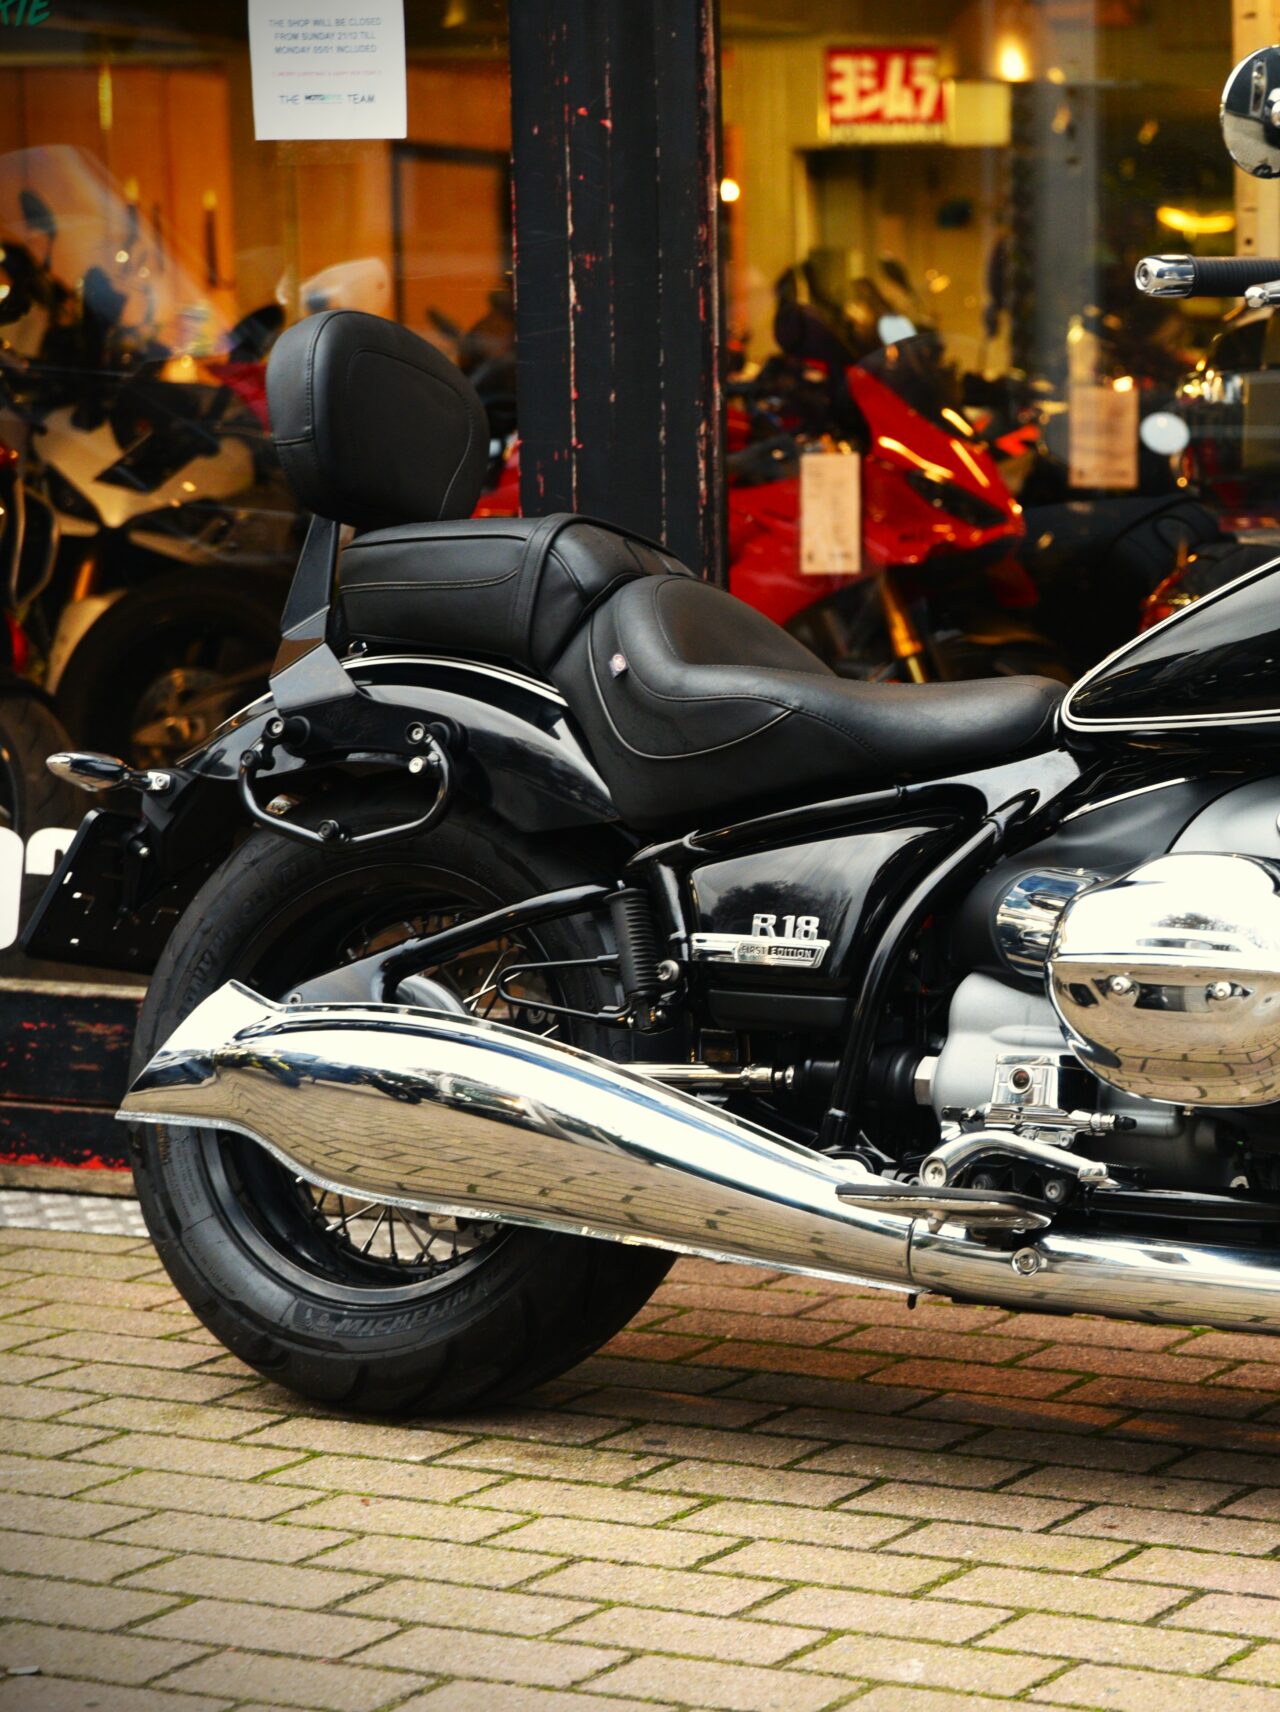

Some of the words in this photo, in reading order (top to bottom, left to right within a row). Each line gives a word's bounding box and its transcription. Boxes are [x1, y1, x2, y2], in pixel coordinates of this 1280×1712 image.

[268, 18, 285, 28] THE
[287, 18, 311, 28] SHOP
[313, 18, 333, 27] WILL
[335, 18, 346, 27] BE
[349, 17, 382, 26] CLOSED
[274, 32, 299, 41] FROM
[301, 32, 336, 40] SUNDAY
[274, 46, 310, 54] MONDAY
[336, 44, 377, 54] INCLUDED
[279, 95, 300, 105] THE
[347, 94, 376, 104] TEAM
[740, 945, 767, 956] FIRST
[770, 947, 813, 959] EDITION
[334, 1286, 471, 1337] MICHELIN
